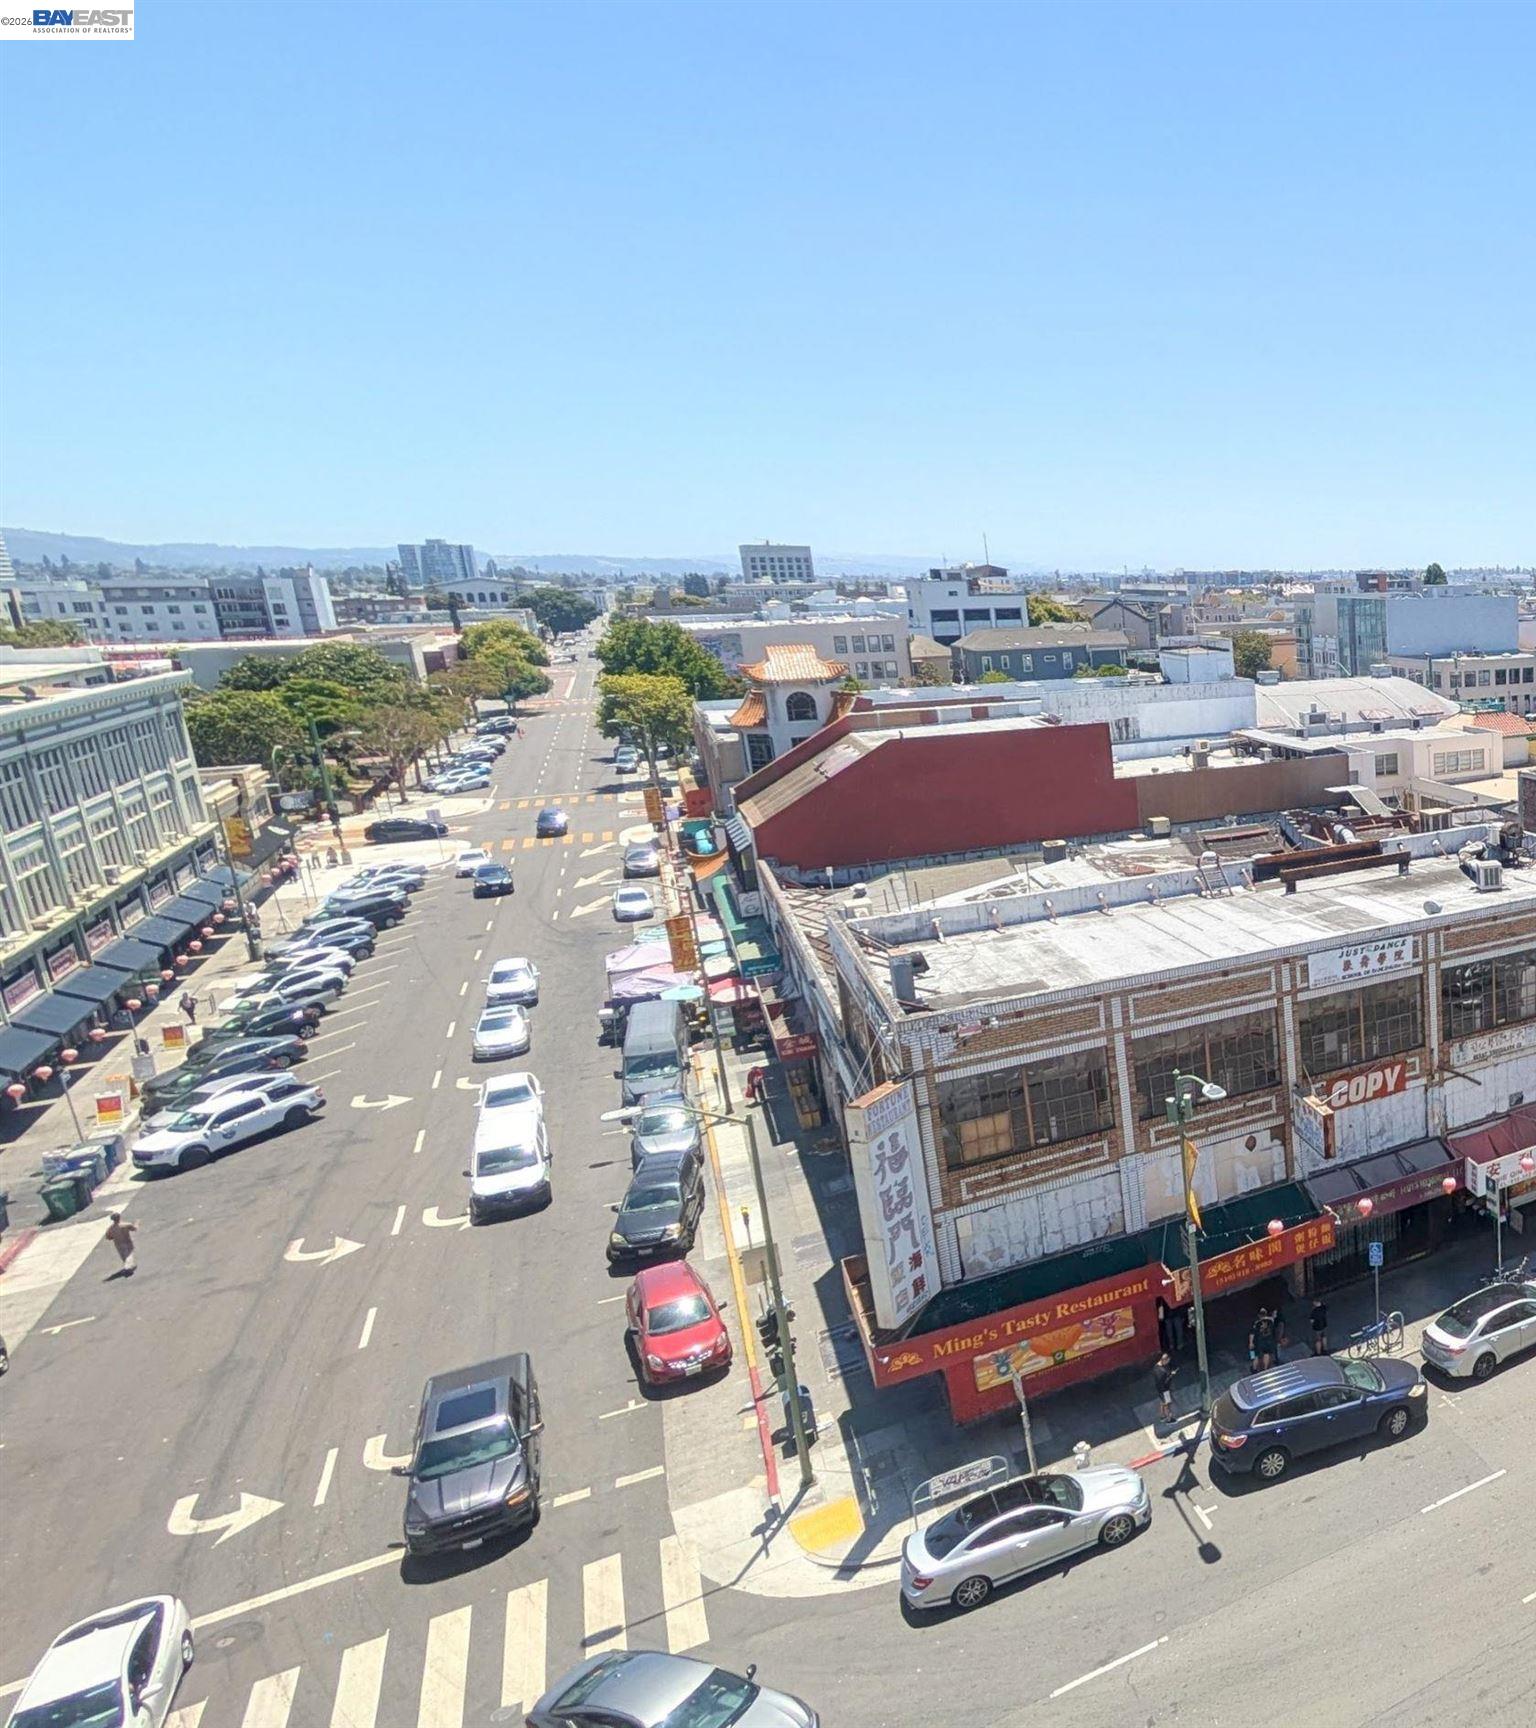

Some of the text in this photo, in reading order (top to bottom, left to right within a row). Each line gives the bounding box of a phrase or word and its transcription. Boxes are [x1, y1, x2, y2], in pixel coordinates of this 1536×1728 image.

[1339, 939, 1407, 959] JUST DANCE
[867, 1085, 910, 1122] FORTUNE
[1331, 1064, 1402, 1107] COPY
[933, 1279, 1150, 1360] Ming's Tasty Restaurant
